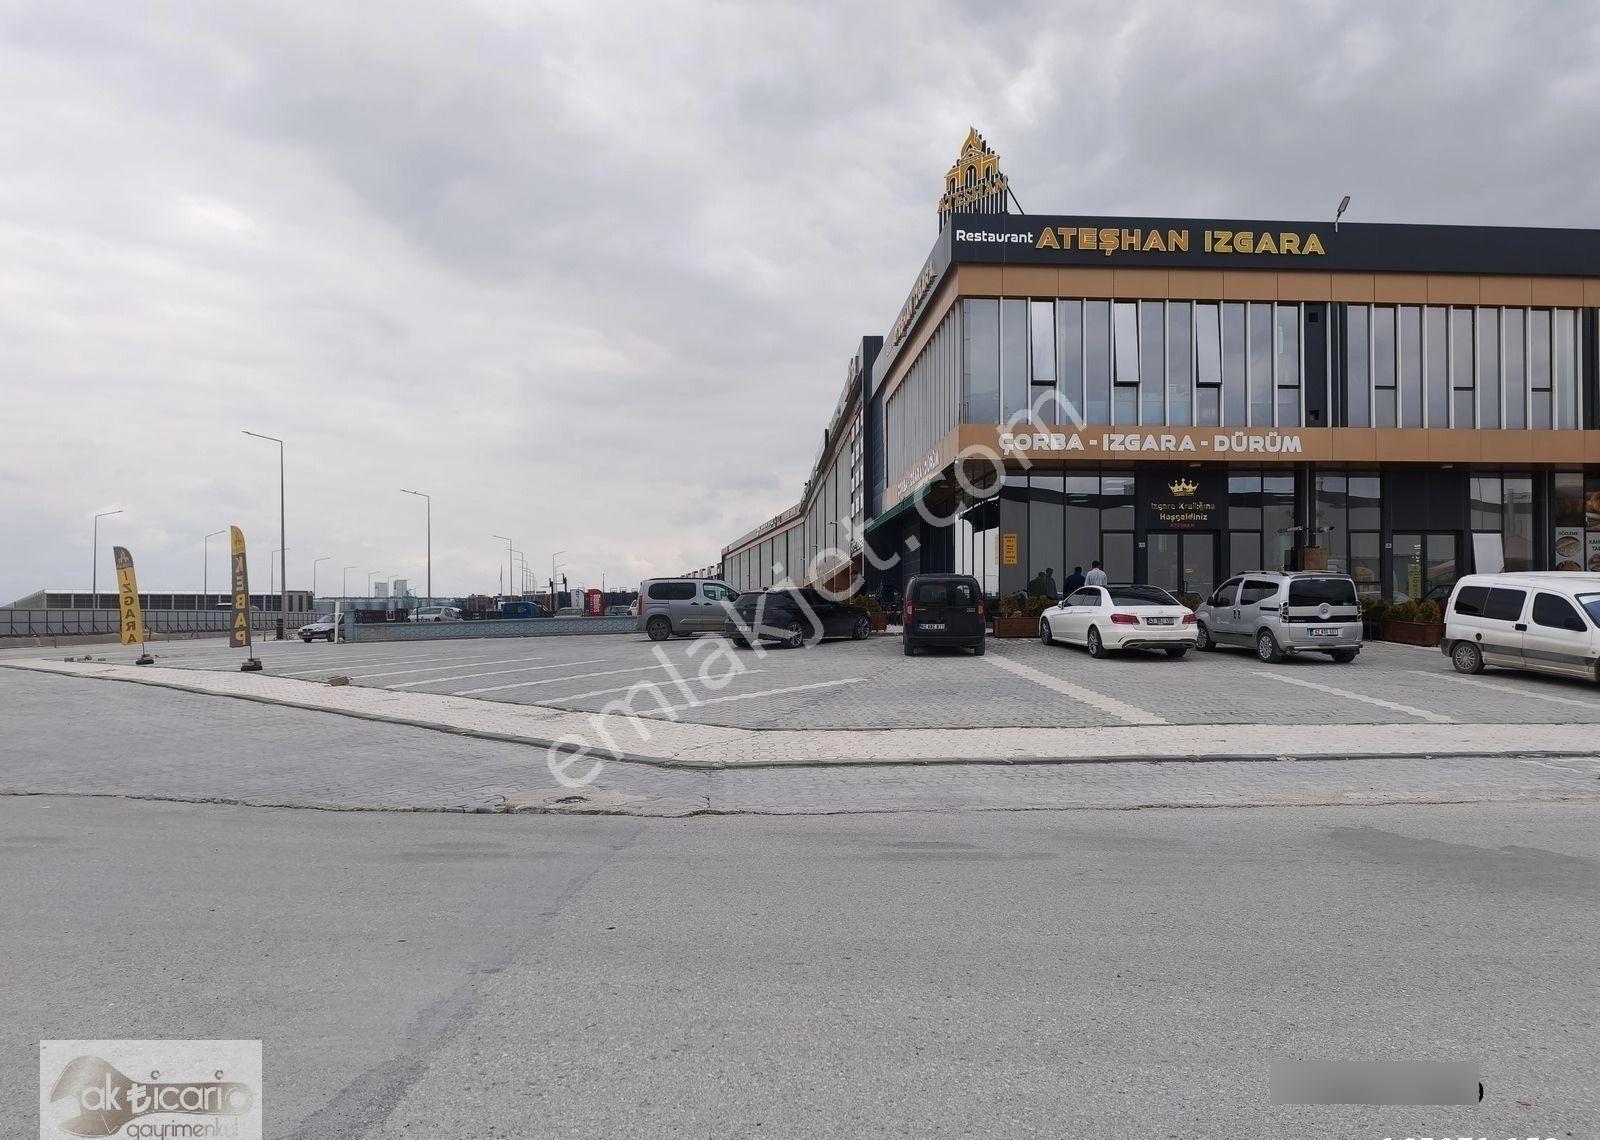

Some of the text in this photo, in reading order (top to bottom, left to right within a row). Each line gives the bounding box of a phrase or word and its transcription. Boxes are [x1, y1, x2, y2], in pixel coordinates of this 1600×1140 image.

[956, 226, 1326, 256] Restaurant ATEŞHAN IZGARA
[998, 433, 1086, 457] ÇORBA
[1102, 433, 1197, 452] IZGARA
[1213, 431, 1303, 453] DÜRÜM
